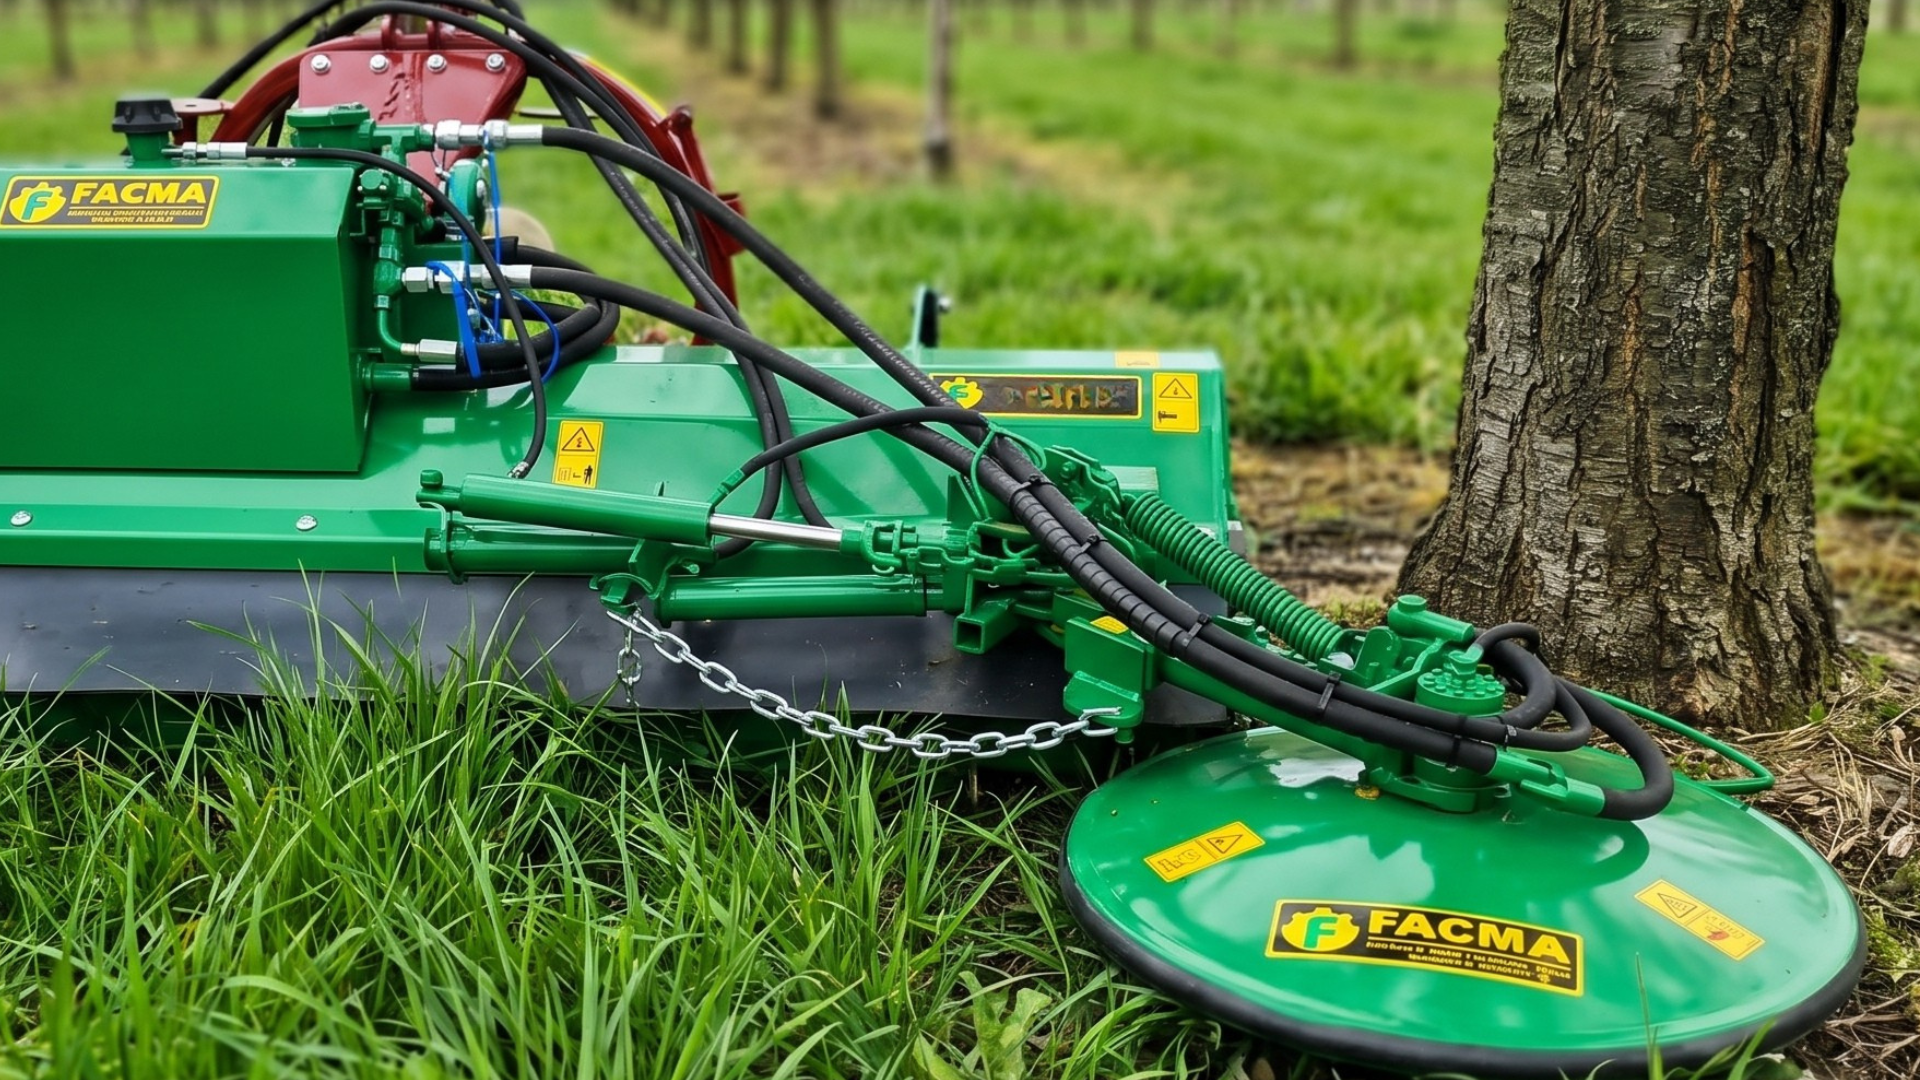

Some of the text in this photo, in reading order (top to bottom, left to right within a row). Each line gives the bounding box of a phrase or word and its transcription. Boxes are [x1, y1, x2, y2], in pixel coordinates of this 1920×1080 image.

[21, 190, 54, 220] F
[71, 182, 207, 204] FACMA
[1303, 916, 1339, 949] F
[1367, 909, 1571, 964] FACMA
